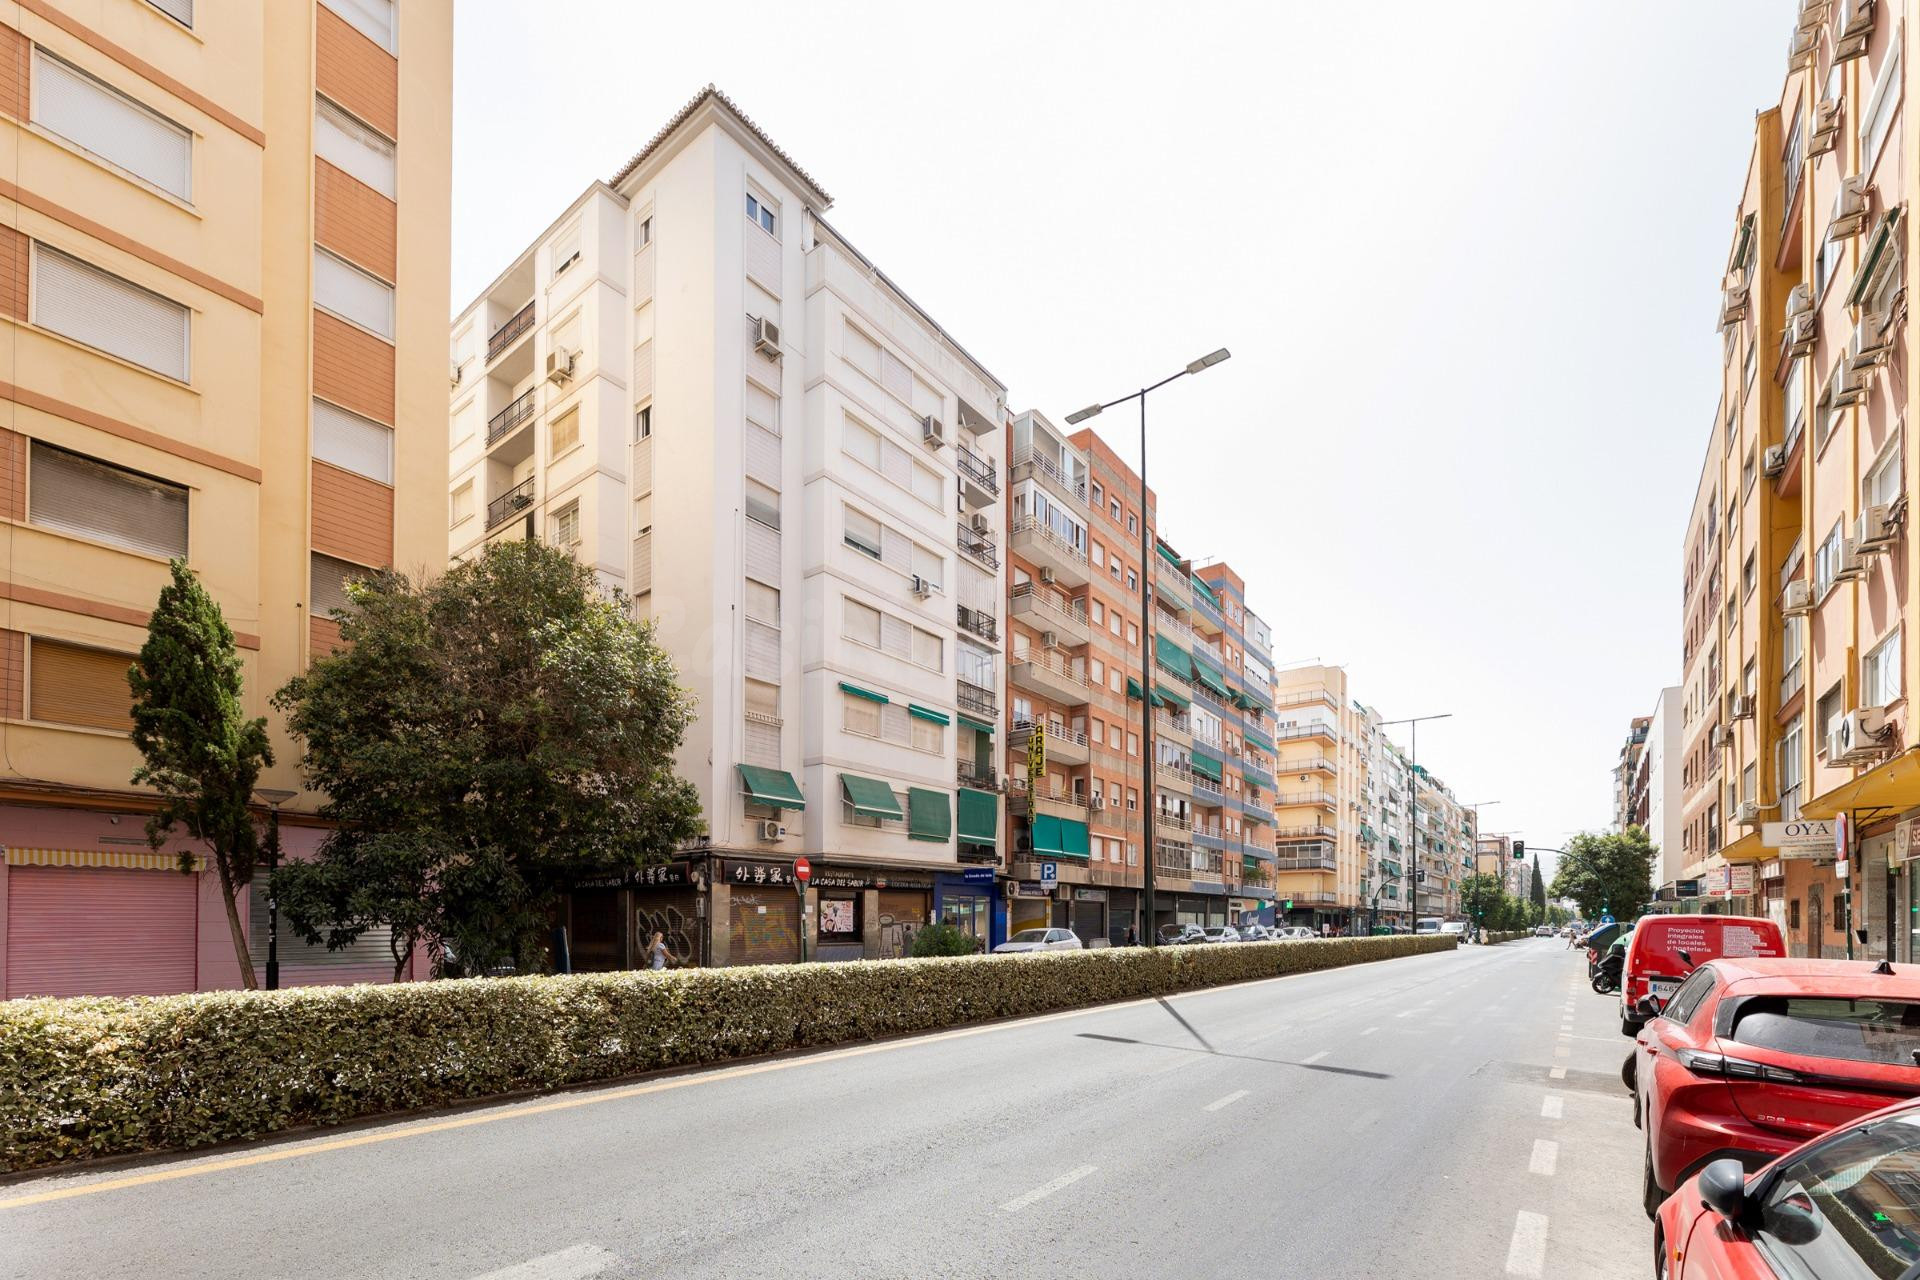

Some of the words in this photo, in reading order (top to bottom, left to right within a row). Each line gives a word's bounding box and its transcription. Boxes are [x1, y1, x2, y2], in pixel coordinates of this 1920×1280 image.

[1785, 822, 1829, 836] OYA
[735, 866, 783, 883] 外婆家
[820, 878, 836, 886] CASA
[836, 878, 846, 886] DEL
[847, 879, 864, 887] SABOR
